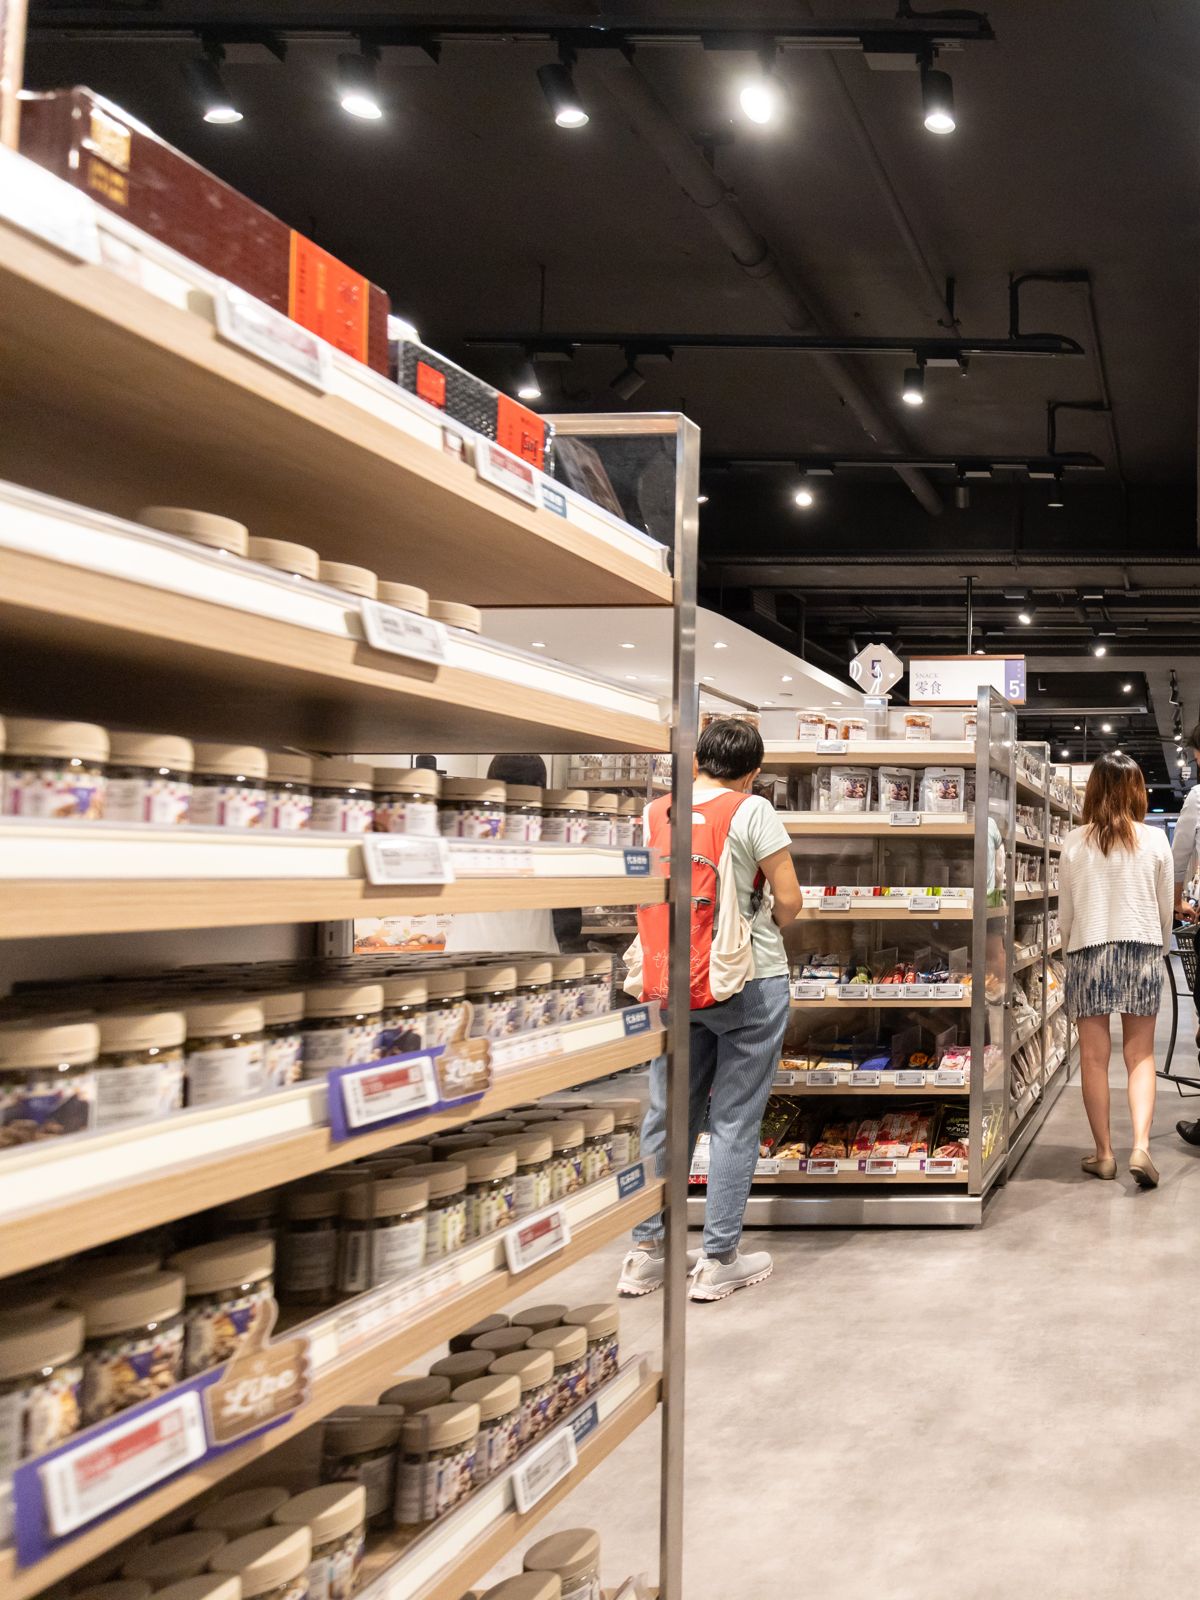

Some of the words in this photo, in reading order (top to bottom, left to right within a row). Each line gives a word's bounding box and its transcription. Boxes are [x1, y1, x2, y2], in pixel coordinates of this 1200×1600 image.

[871, 659, 882, 679] 5
[915, 680, 943, 696] 零食
[1009, 680, 1020, 698] 5
[220, 1367, 297, 1418] Like
